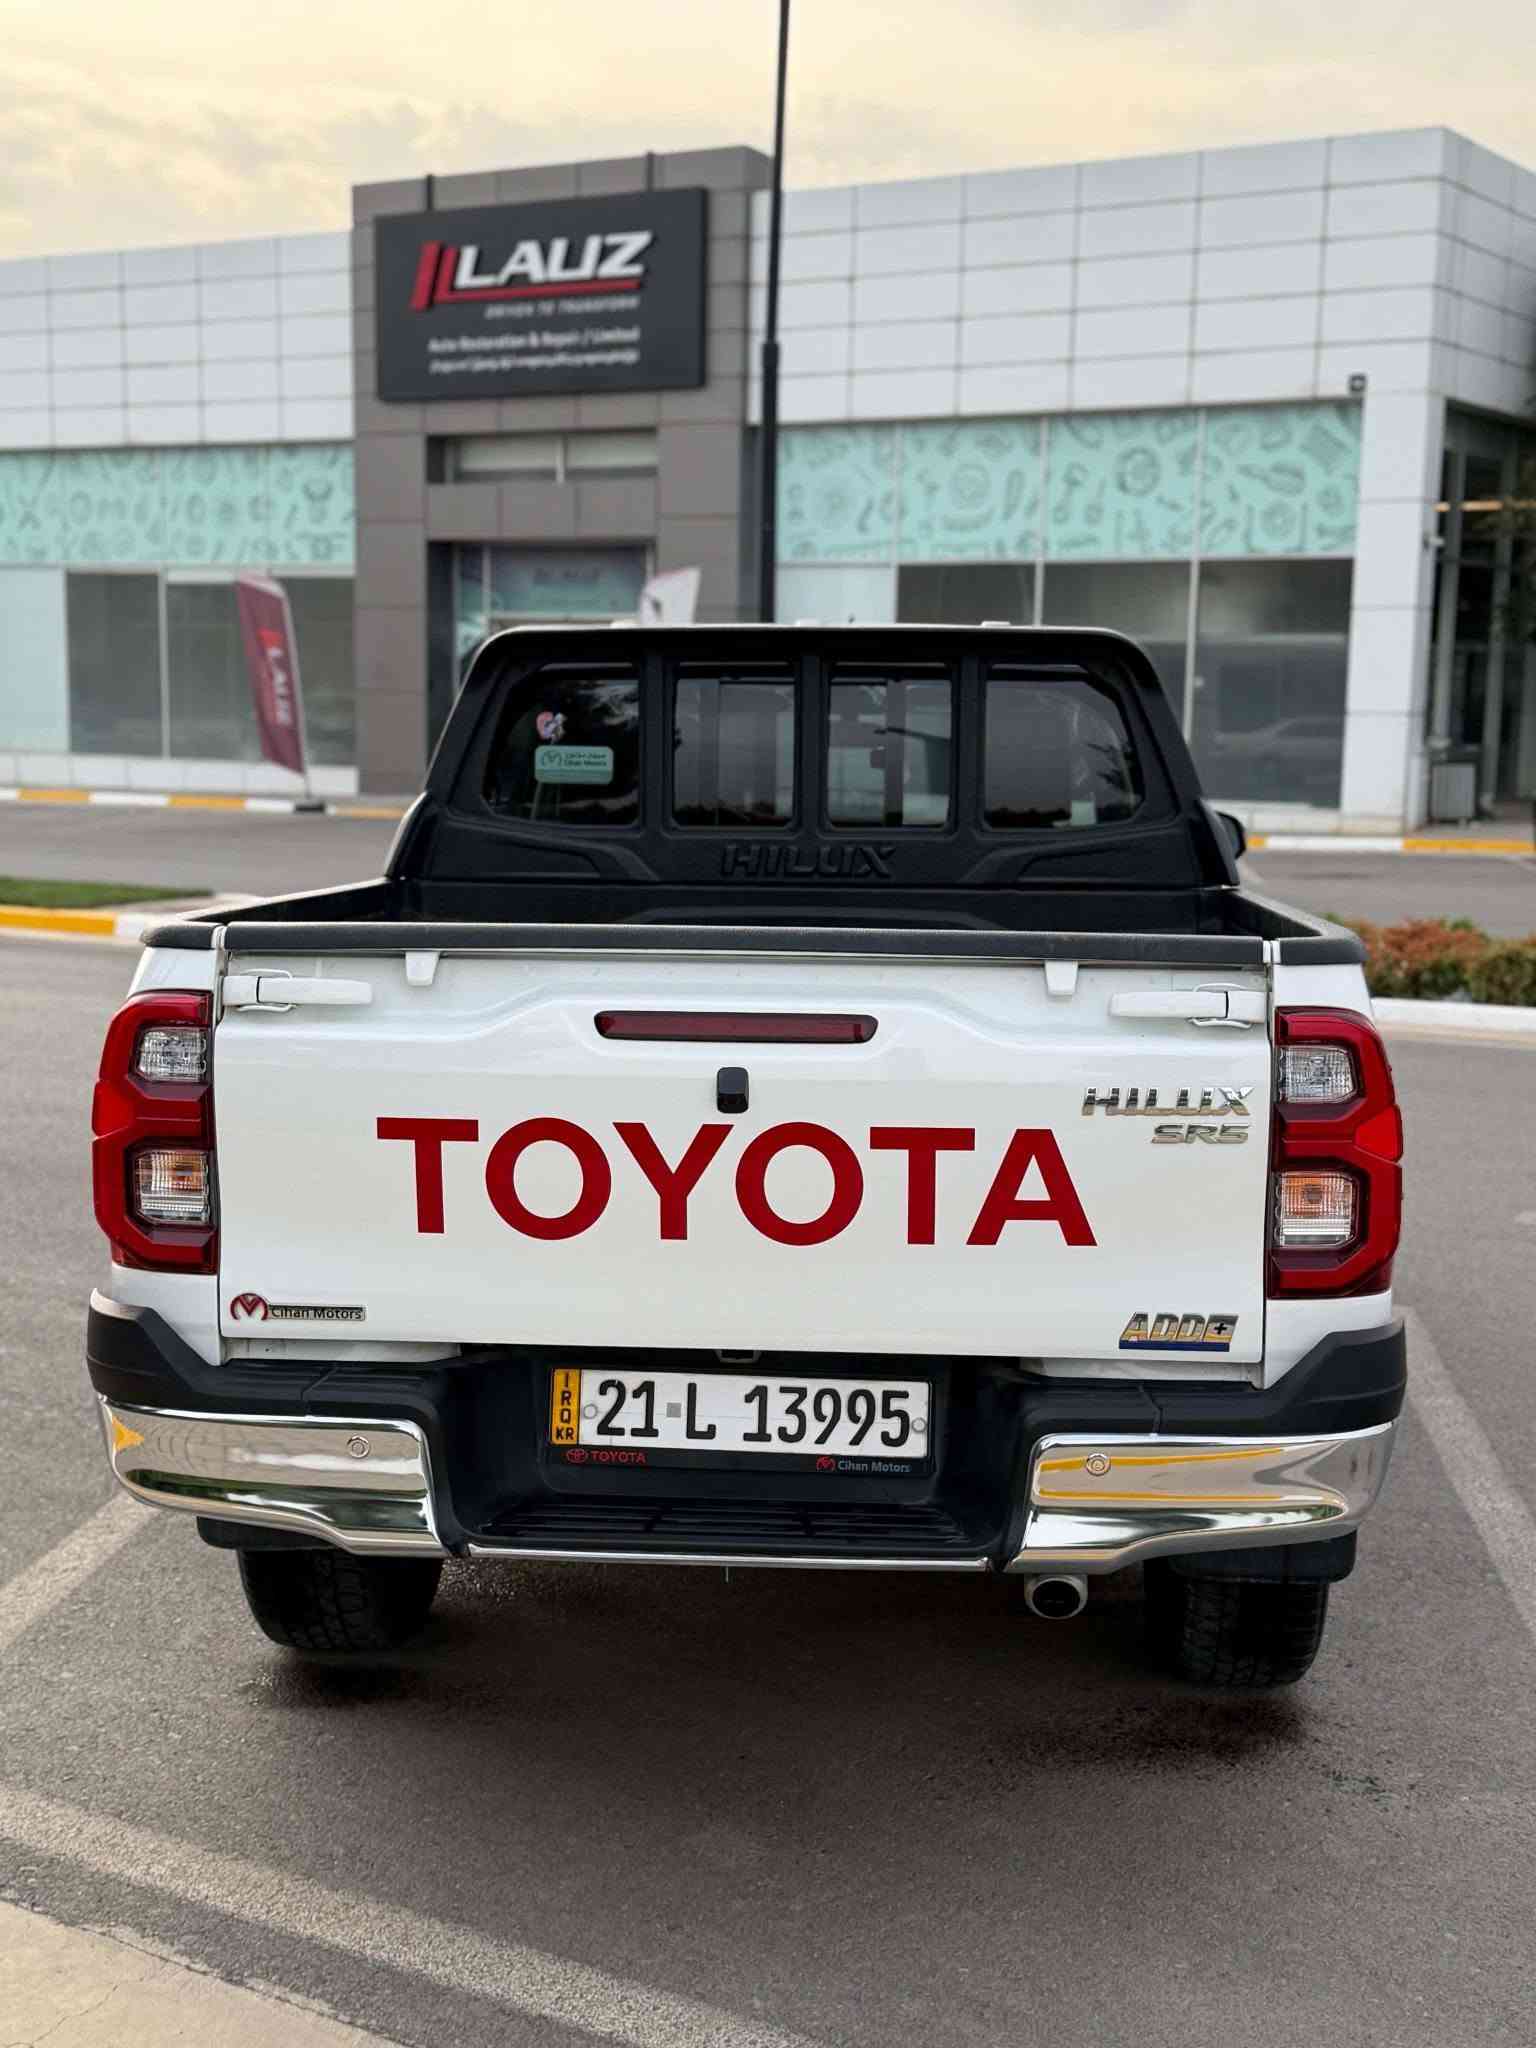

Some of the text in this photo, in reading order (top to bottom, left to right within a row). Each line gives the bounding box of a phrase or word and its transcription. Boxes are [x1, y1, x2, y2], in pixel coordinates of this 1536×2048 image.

[454, 231, 653, 289] LAUZ
[722, 845, 895, 877] HILUX
[1081, 1087, 1254, 1117] HILUX
[1151, 1123, 1250, 1145] SR5
[377, 1117, 1098, 1247] TOYOTA
[271, 1306, 361, 1321] Cihan Motors
[596, 1379, 910, 1447] 21 L 13995
[556, 1427, 574, 1440] KR
[591, 1449, 647, 1463] TOYOTA
[837, 1459, 912, 1473] Cihan Motors
